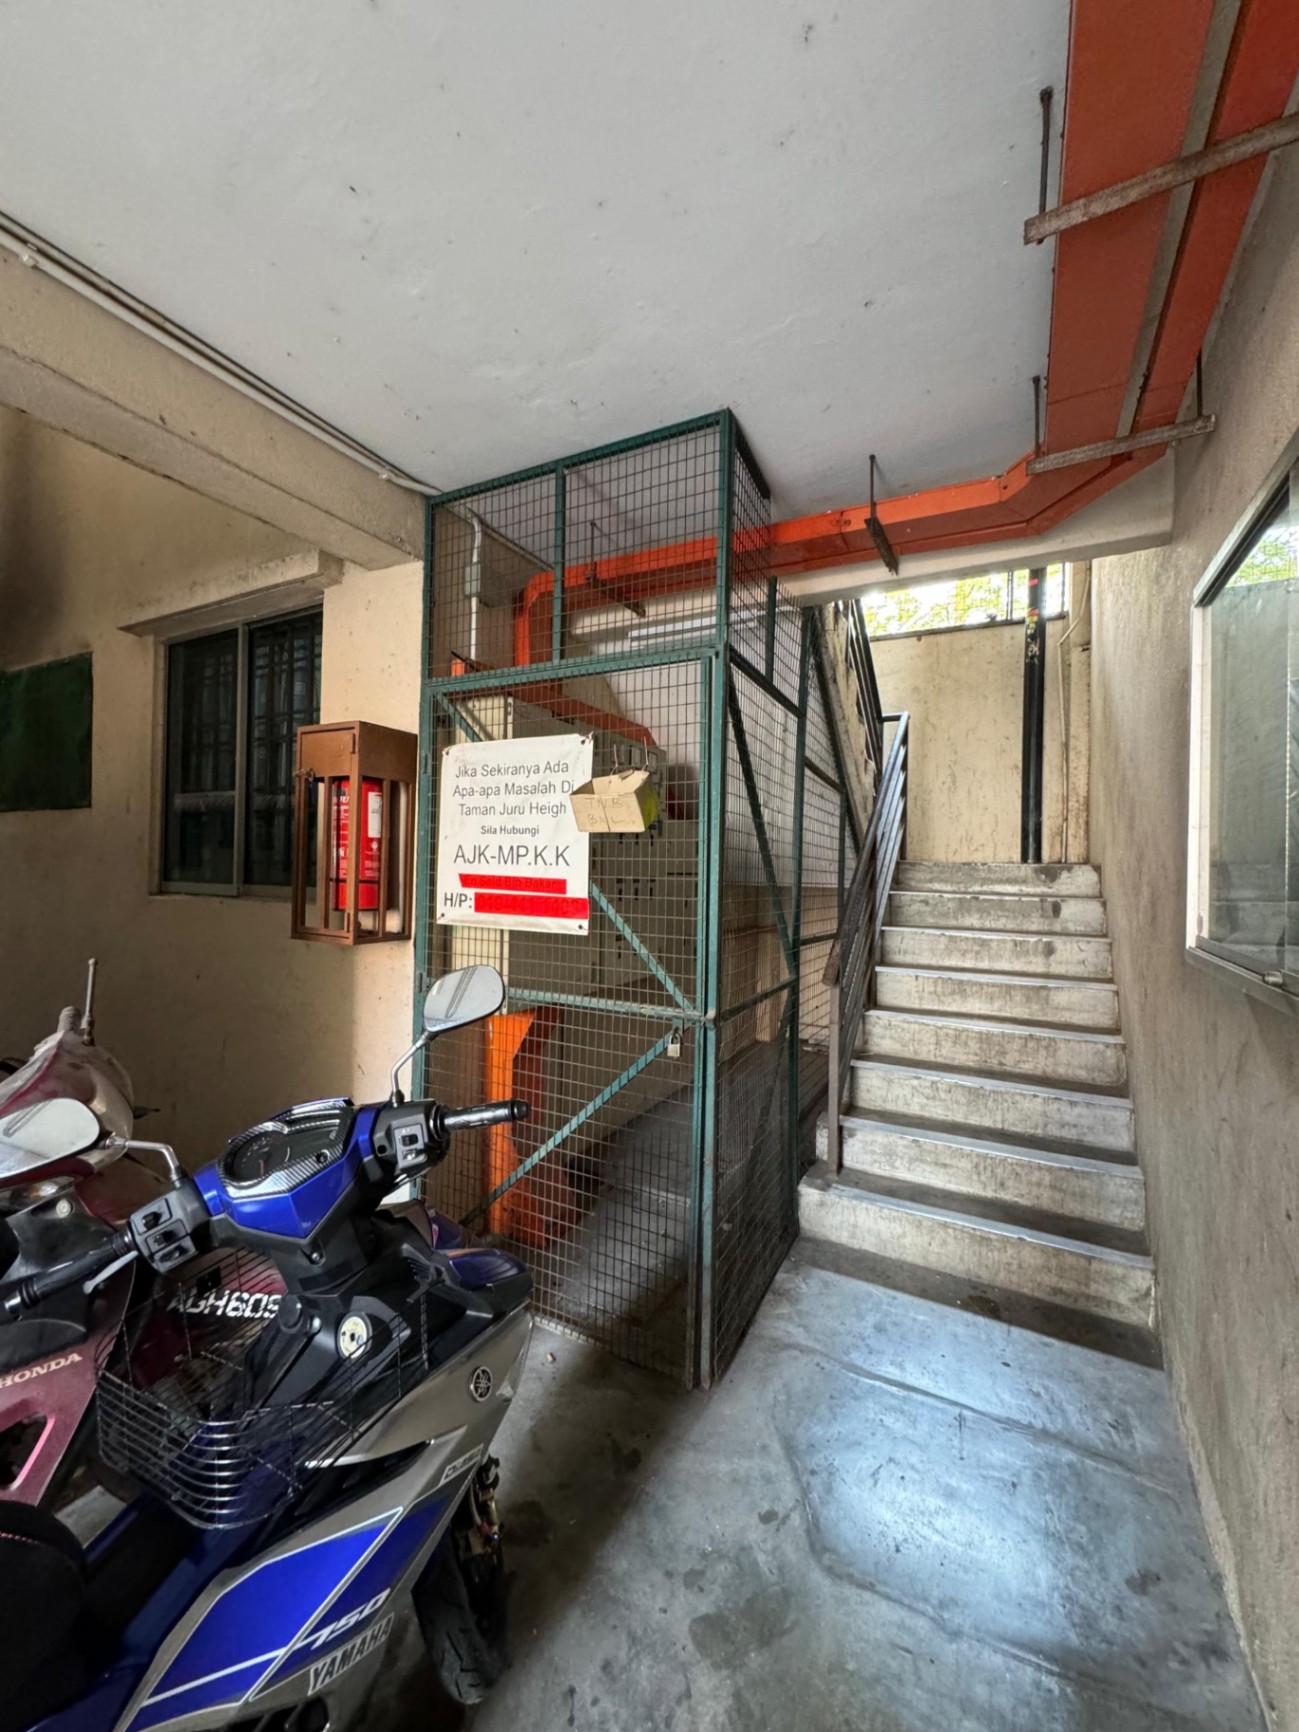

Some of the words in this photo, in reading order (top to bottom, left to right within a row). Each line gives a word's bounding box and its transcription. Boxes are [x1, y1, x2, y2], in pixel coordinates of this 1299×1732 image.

[455, 765, 477, 778] Jika
[481, 762, 540, 779] Sekiranya
[543, 760, 569, 774] Ada
[453, 784, 500, 799] Apa-apa
[504, 780, 556, 796] Masalah
[458, 803, 496, 816] Taman
[499, 803, 525, 816] Juru
[480, 825, 497, 835] Sila
[499, 825, 540, 838] Hubungi
[443, 892, 473, 909] H/P:
[0, 1352, 84, 1389] HONDA
[308, 1613, 394, 1695] YAMAHA
